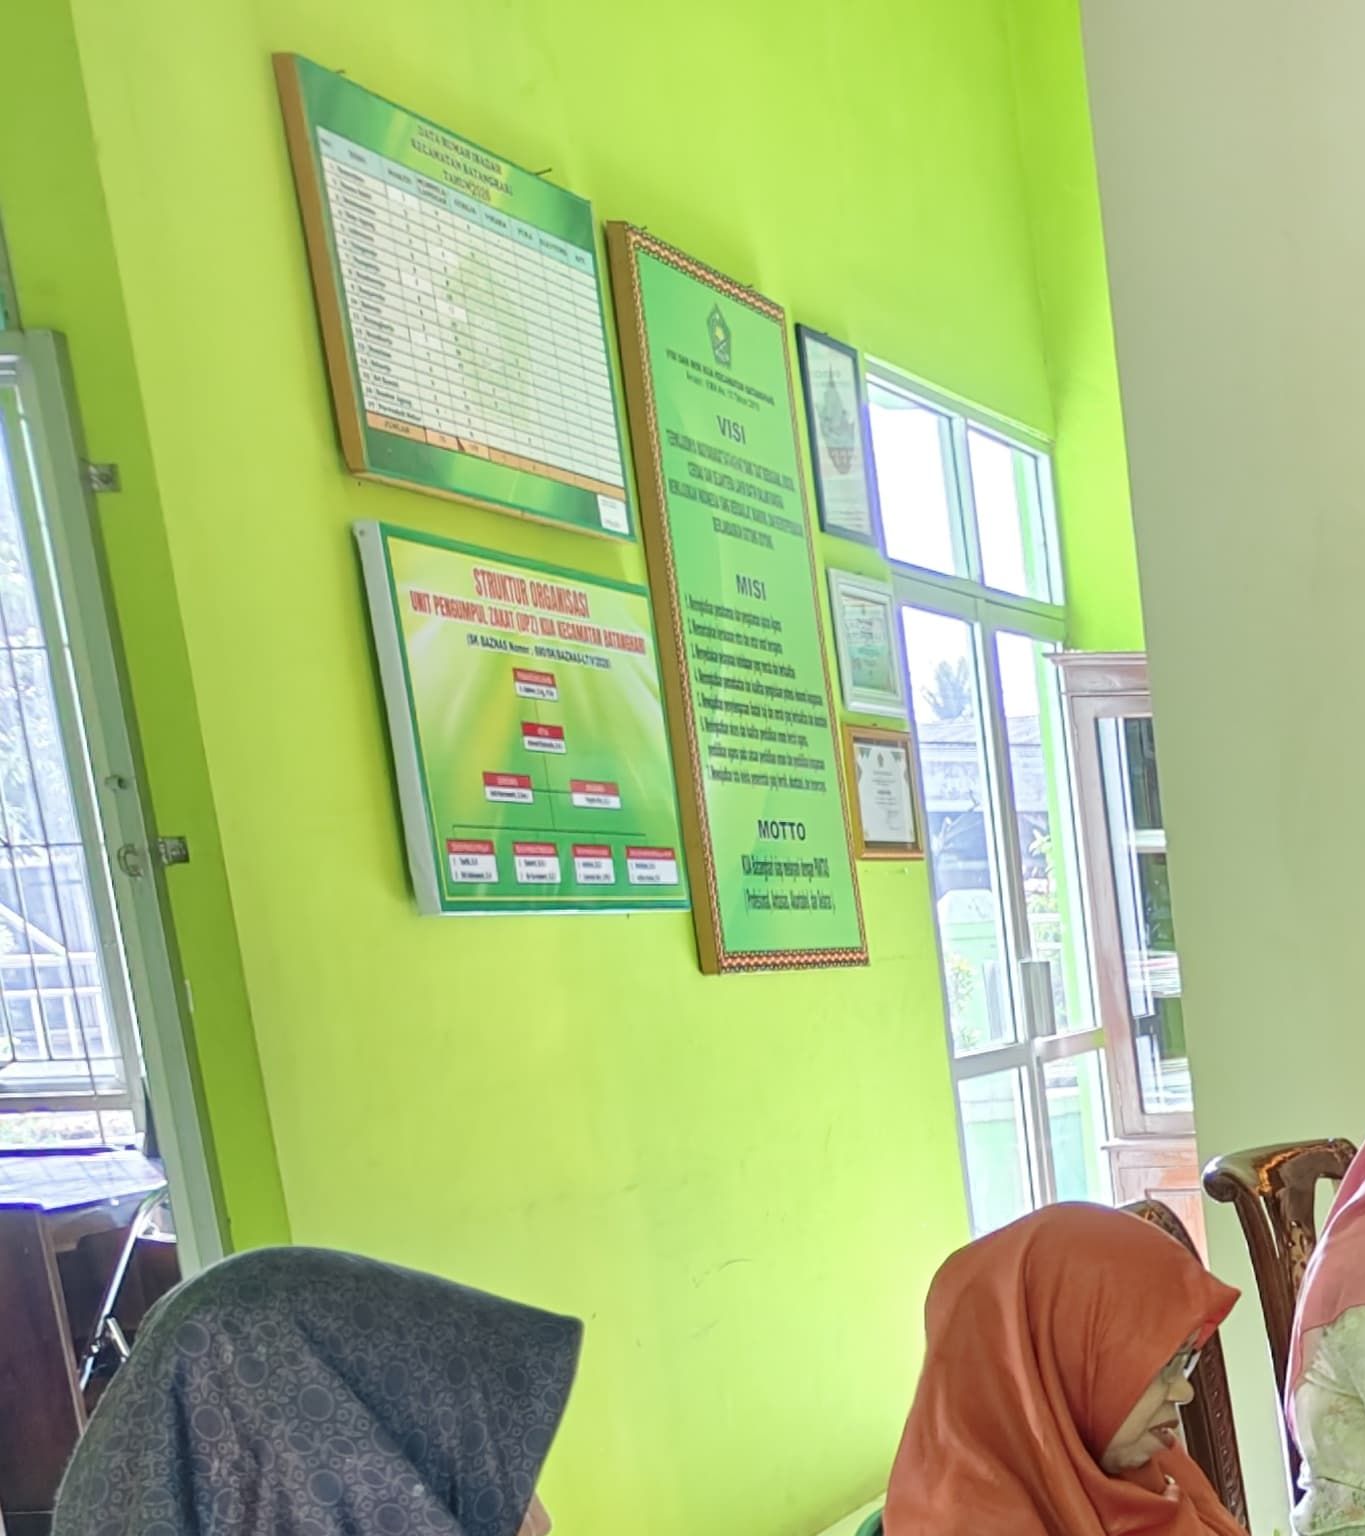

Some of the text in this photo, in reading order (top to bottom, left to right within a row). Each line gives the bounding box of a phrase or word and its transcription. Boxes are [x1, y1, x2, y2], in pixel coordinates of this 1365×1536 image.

[716, 415, 746, 444] VISI
[472, 567, 590, 618] STRUKTUR ORGANISASI
[735, 574, 767, 601] MISI
[410, 590, 432, 614] UNIT
[432, 594, 488, 624] PENGUMPUL
[758, 819, 806, 840] MOTTO
